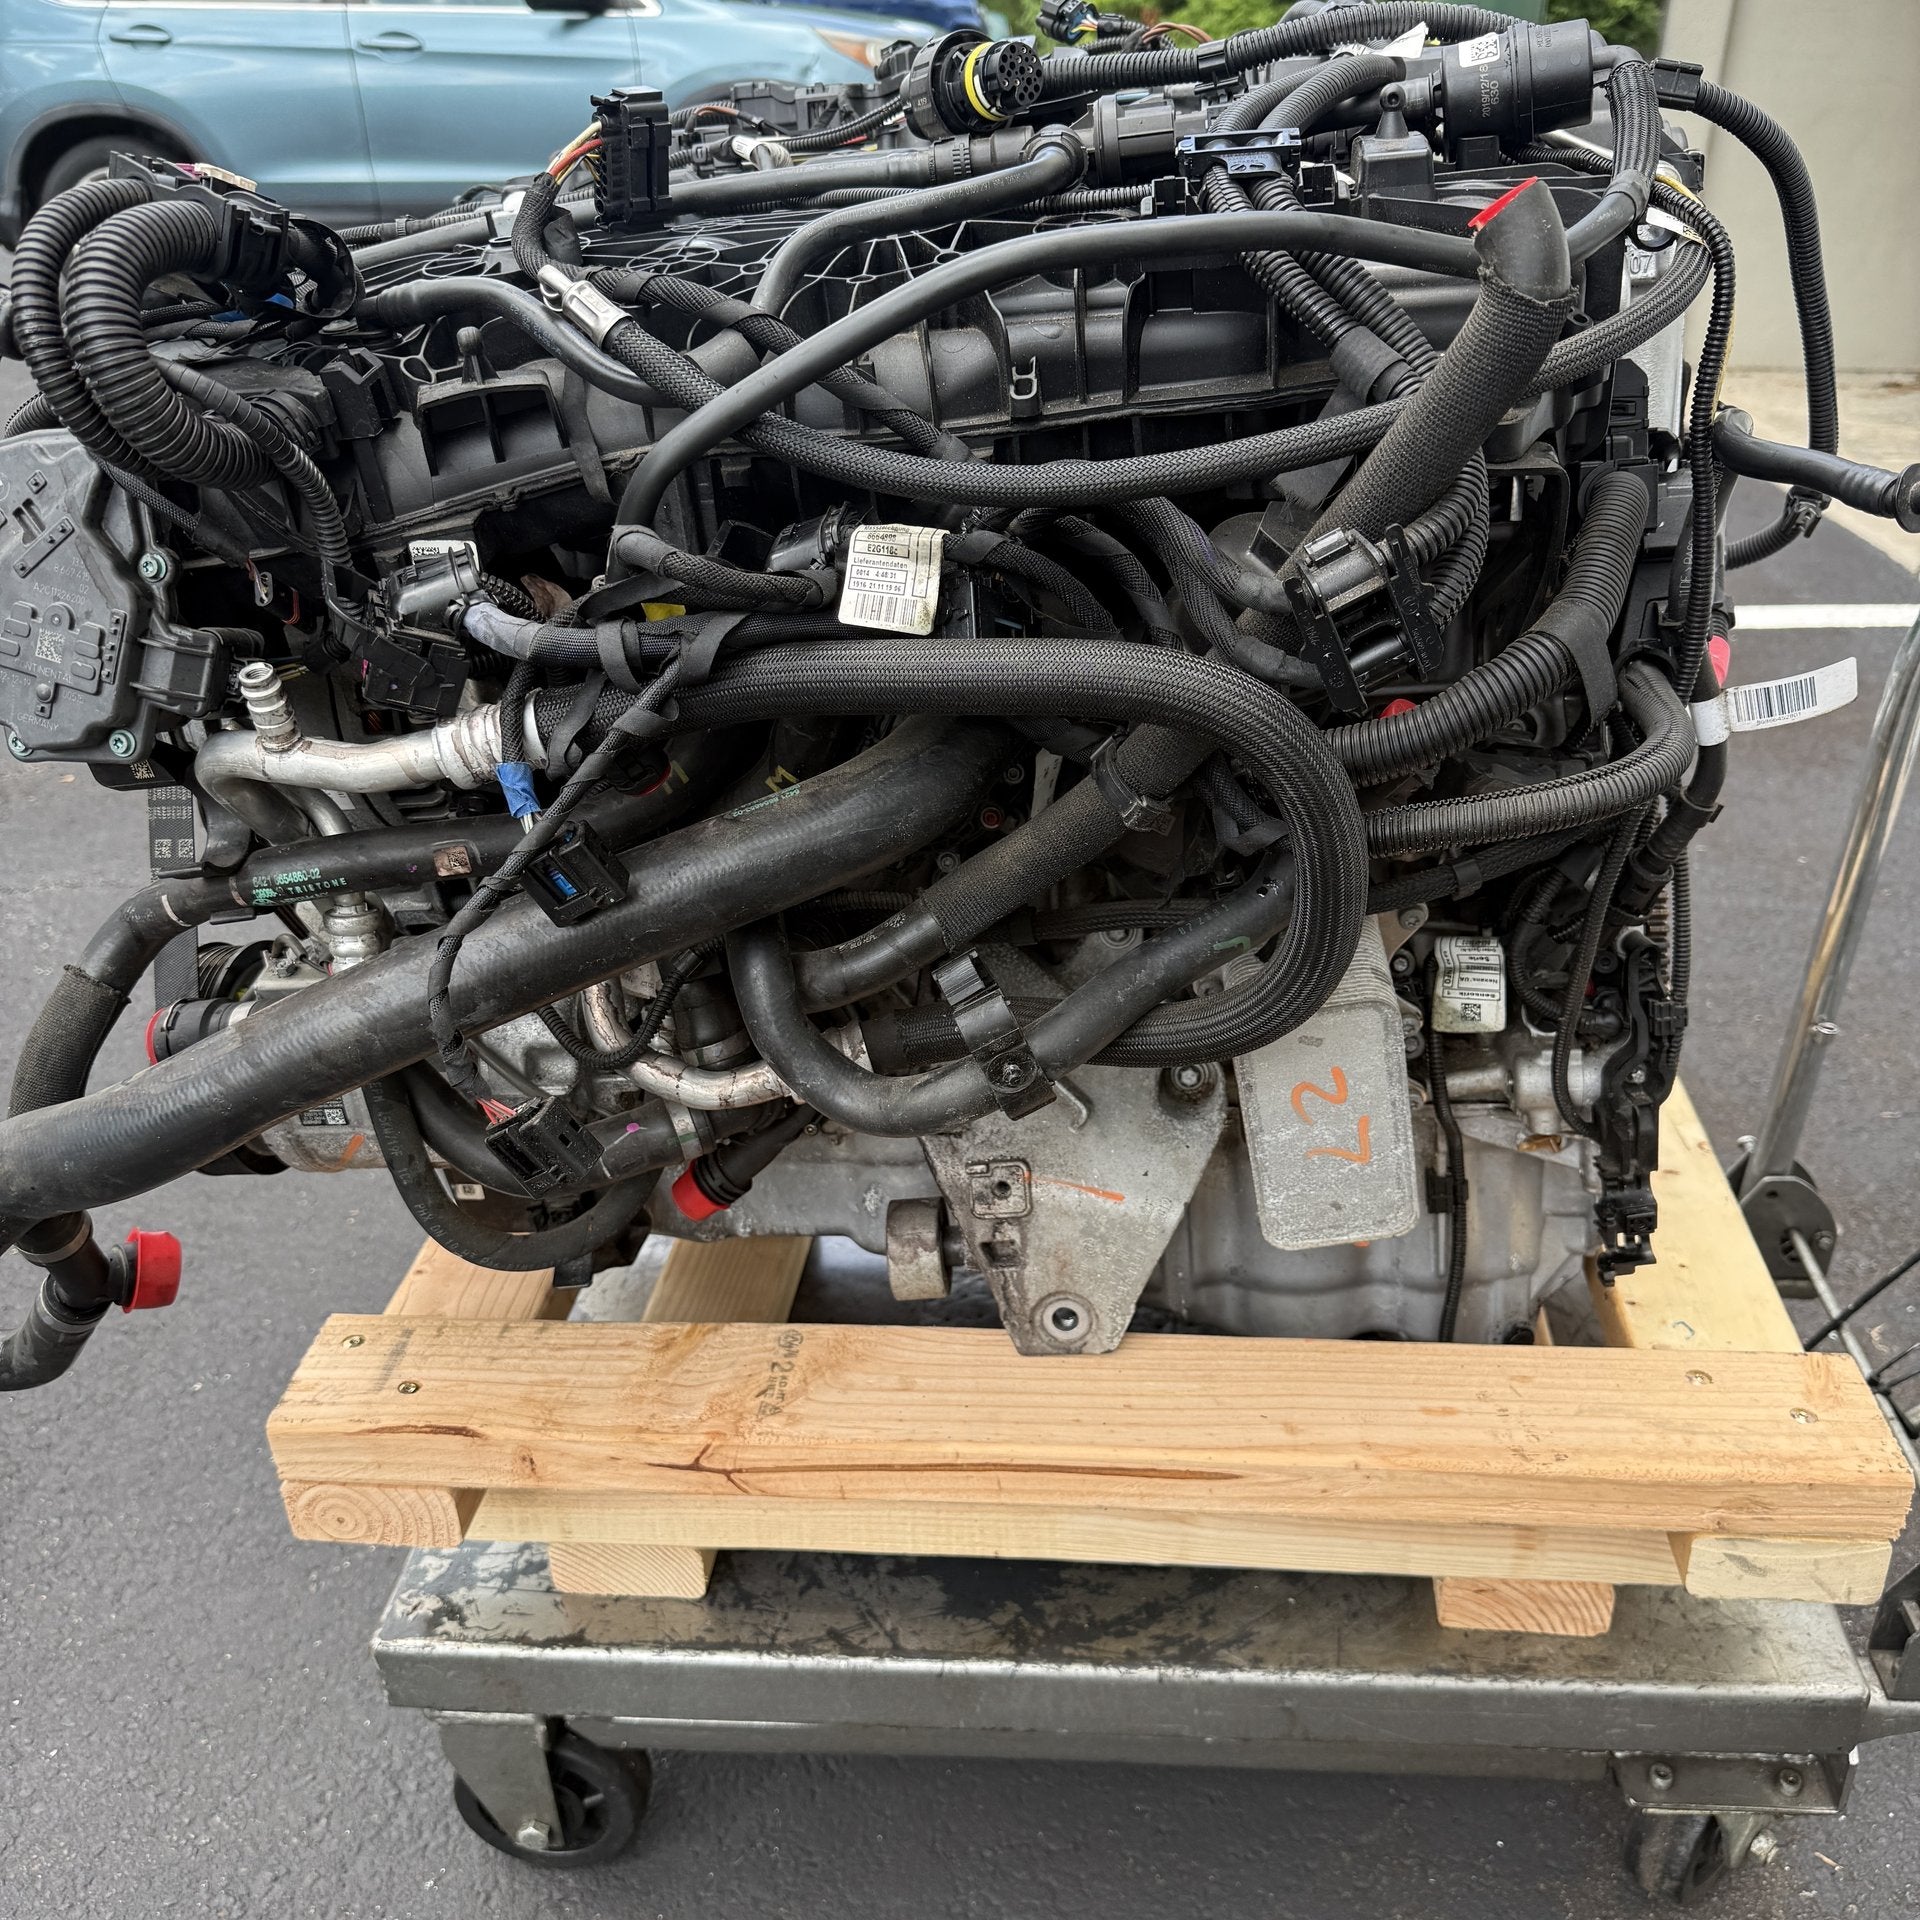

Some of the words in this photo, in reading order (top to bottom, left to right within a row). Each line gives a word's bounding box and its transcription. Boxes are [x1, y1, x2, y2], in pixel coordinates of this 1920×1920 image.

[1479, 64, 1491, 118] 2019/12/18
[1490, 80, 1499, 105] 630
[1629, 255, 1654, 275] 07
[853, 557, 908, 569] Lieferantendaten
